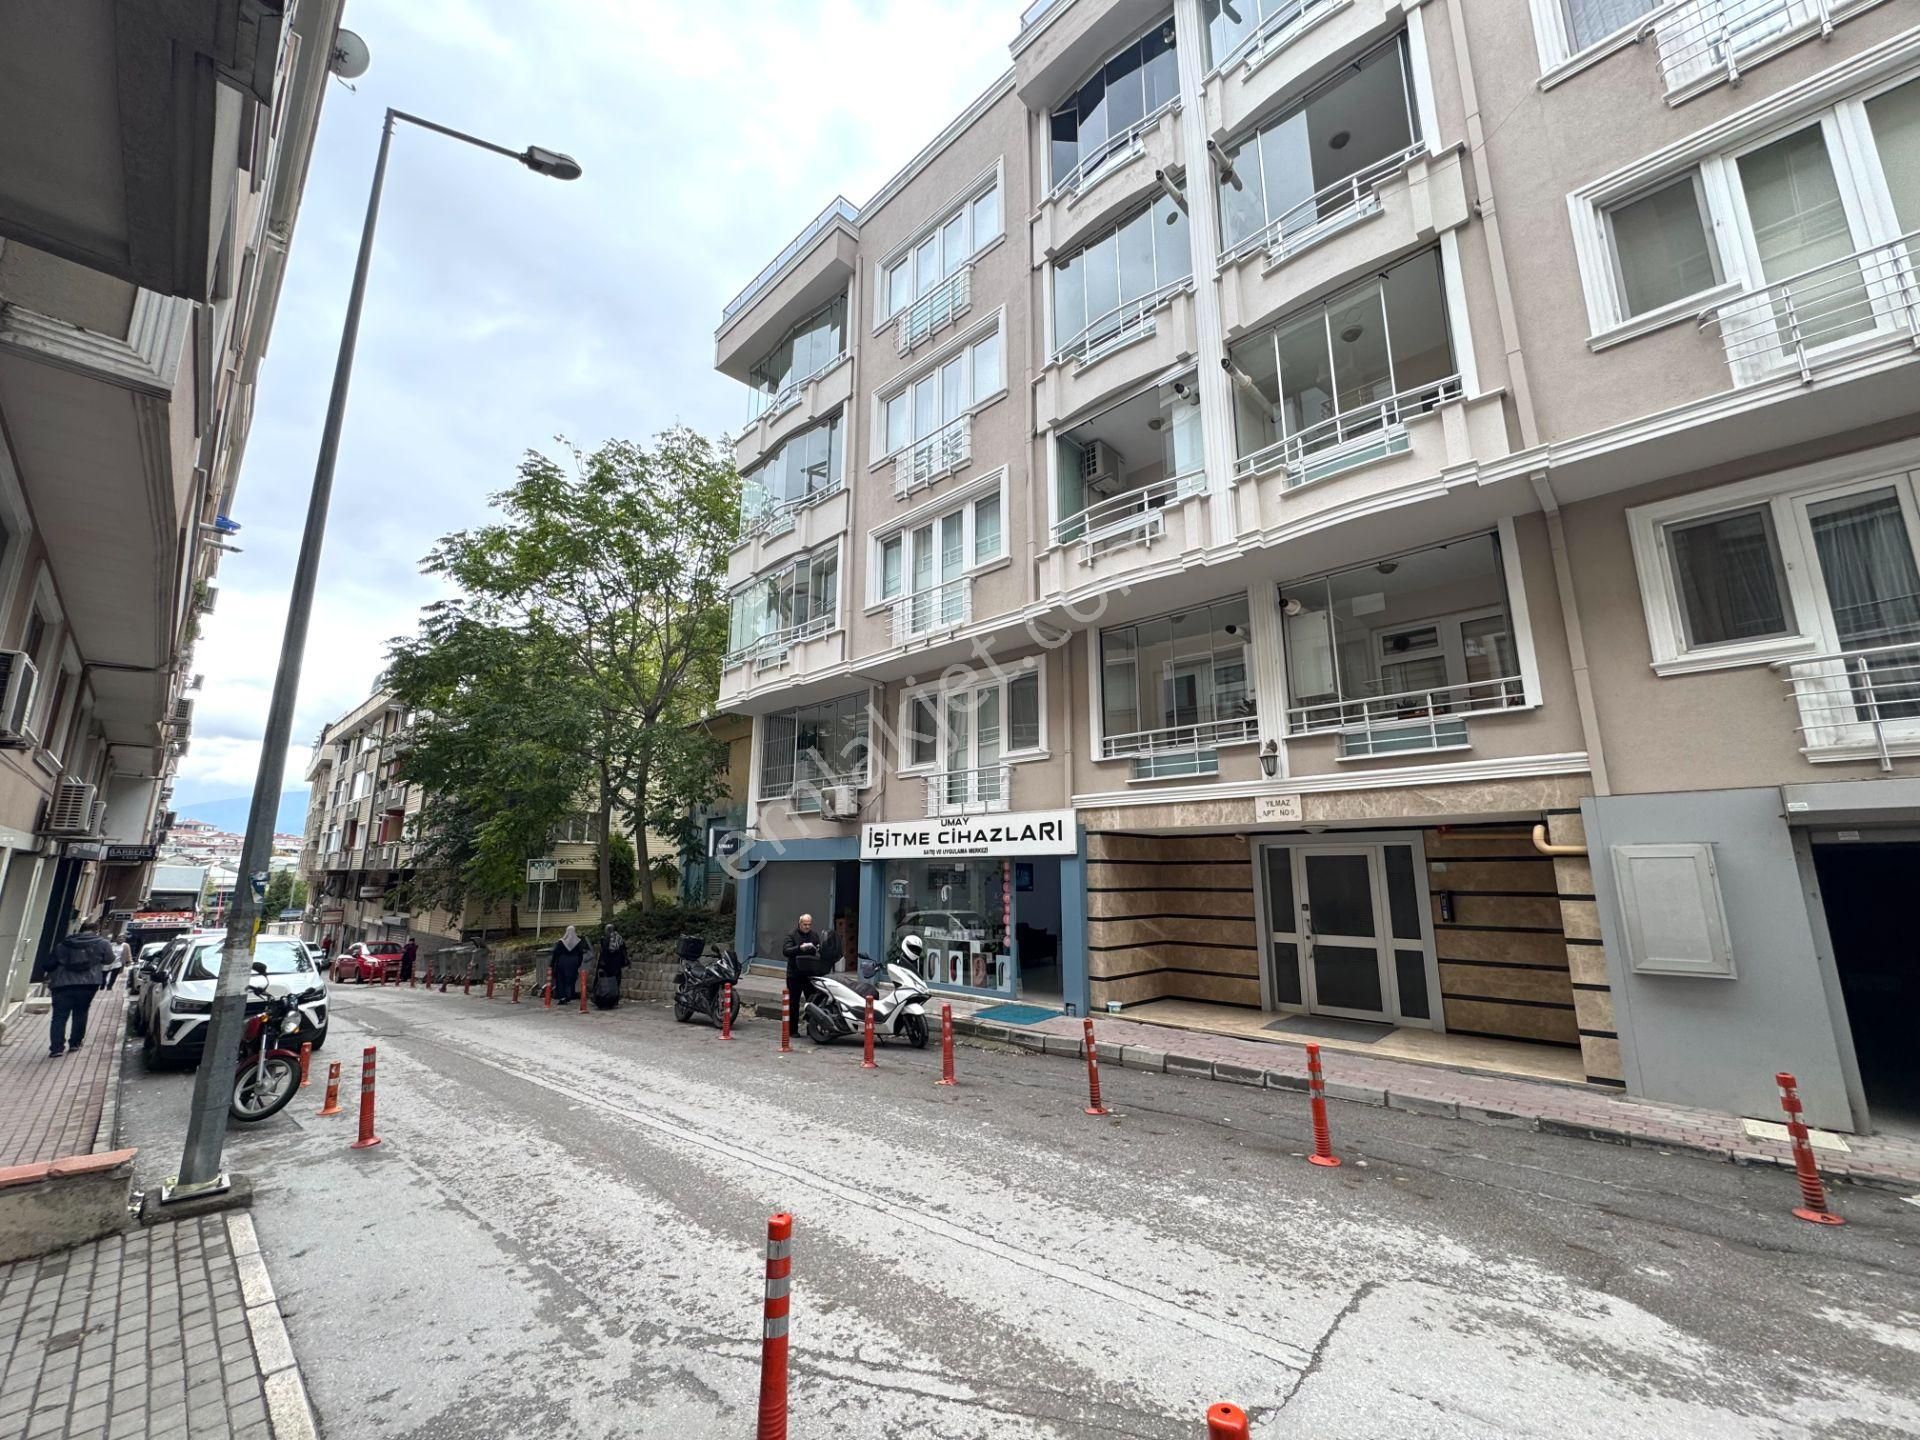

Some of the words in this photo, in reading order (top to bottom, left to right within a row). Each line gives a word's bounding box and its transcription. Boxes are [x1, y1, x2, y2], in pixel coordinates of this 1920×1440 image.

[940, 817, 970, 827] UMAY
[868, 827, 930, 856] İŞİTME
[937, 819, 1063, 845] CİHAZLARI
